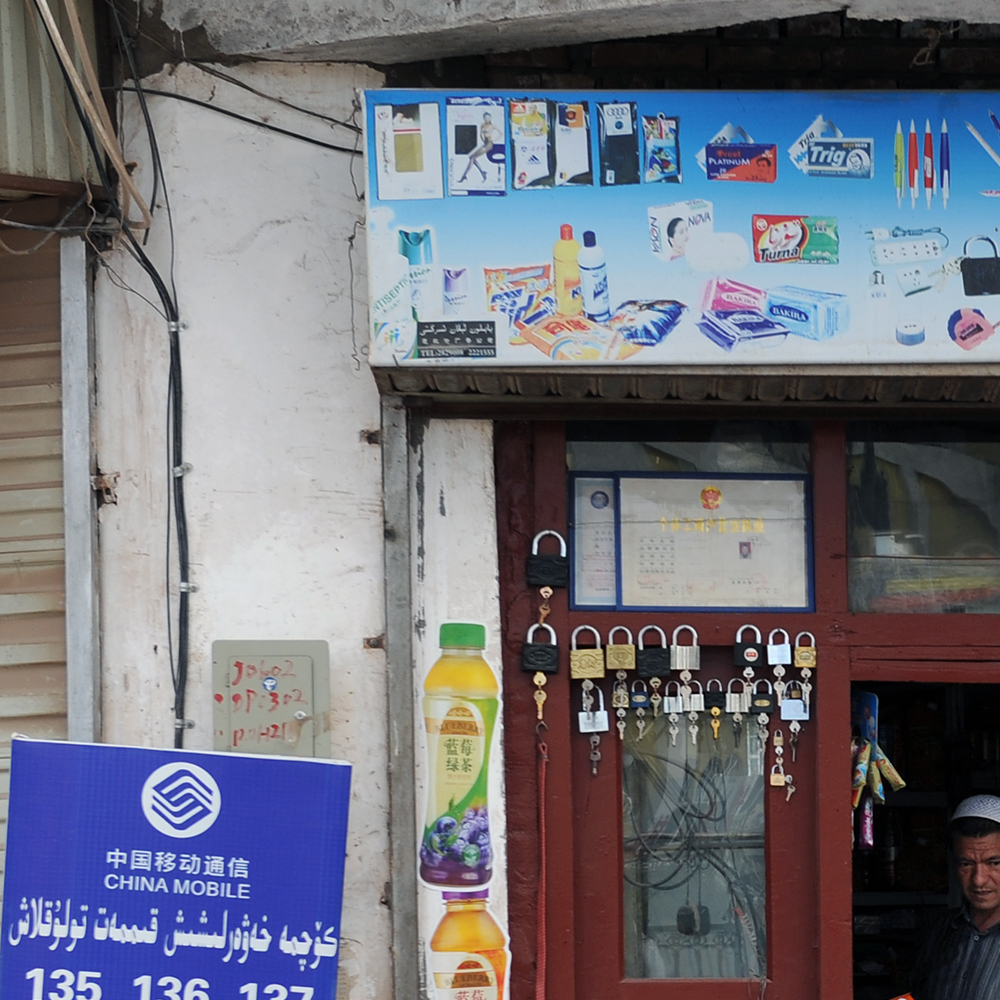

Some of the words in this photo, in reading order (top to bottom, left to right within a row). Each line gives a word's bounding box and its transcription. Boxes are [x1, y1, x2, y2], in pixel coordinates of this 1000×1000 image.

[708, 157, 750, 167] PLATINUM
[810, 147, 845, 167] Trig
[687, 211, 712, 227] NOVA
[649, 216, 660, 253] NOVA
[105, 847, 252, 880] 中国移动通信
[103, 872, 169, 895] CHINA
[173, 876, 252, 900] MOBILE
